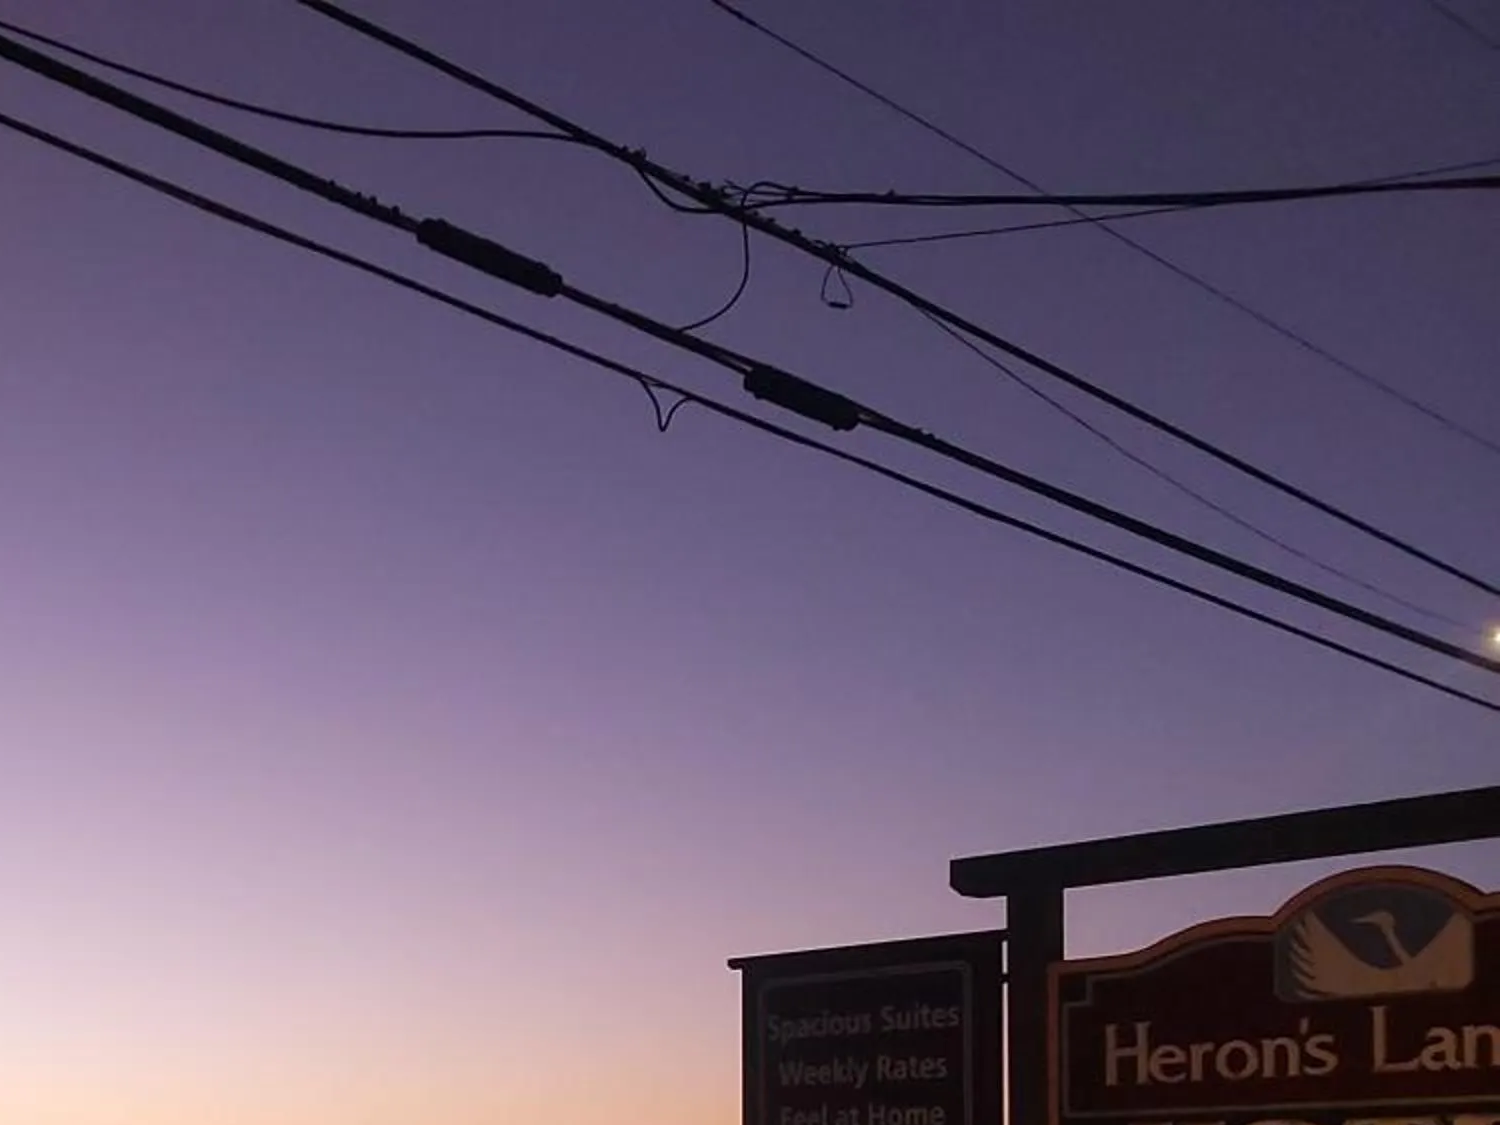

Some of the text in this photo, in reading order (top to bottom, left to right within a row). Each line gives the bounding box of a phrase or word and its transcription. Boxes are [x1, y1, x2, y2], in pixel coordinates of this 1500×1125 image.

[767, 1002, 961, 1047] Spacious Suites
[1105, 1005, 1500, 1086] Heron's Lan
[778, 1055, 948, 1089] Weekly Rates
